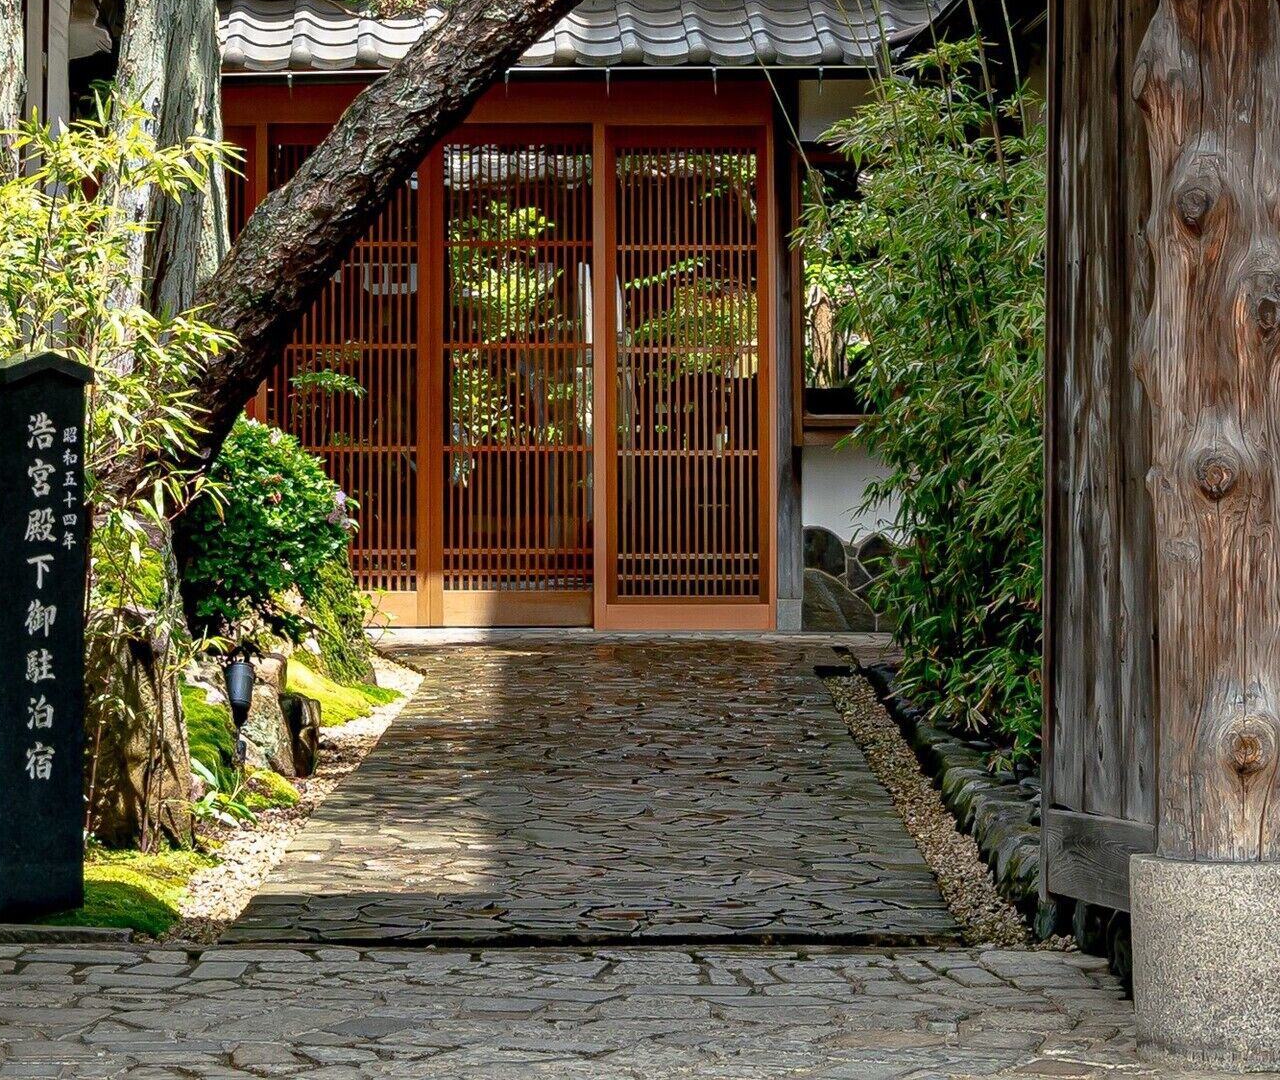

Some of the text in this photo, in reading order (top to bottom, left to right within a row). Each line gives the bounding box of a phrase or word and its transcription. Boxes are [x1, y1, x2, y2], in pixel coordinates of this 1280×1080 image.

[24, 411, 57, 781] 浩宮殿下御駐泊宿
[62, 426, 78, 551] 昭和五十四年
